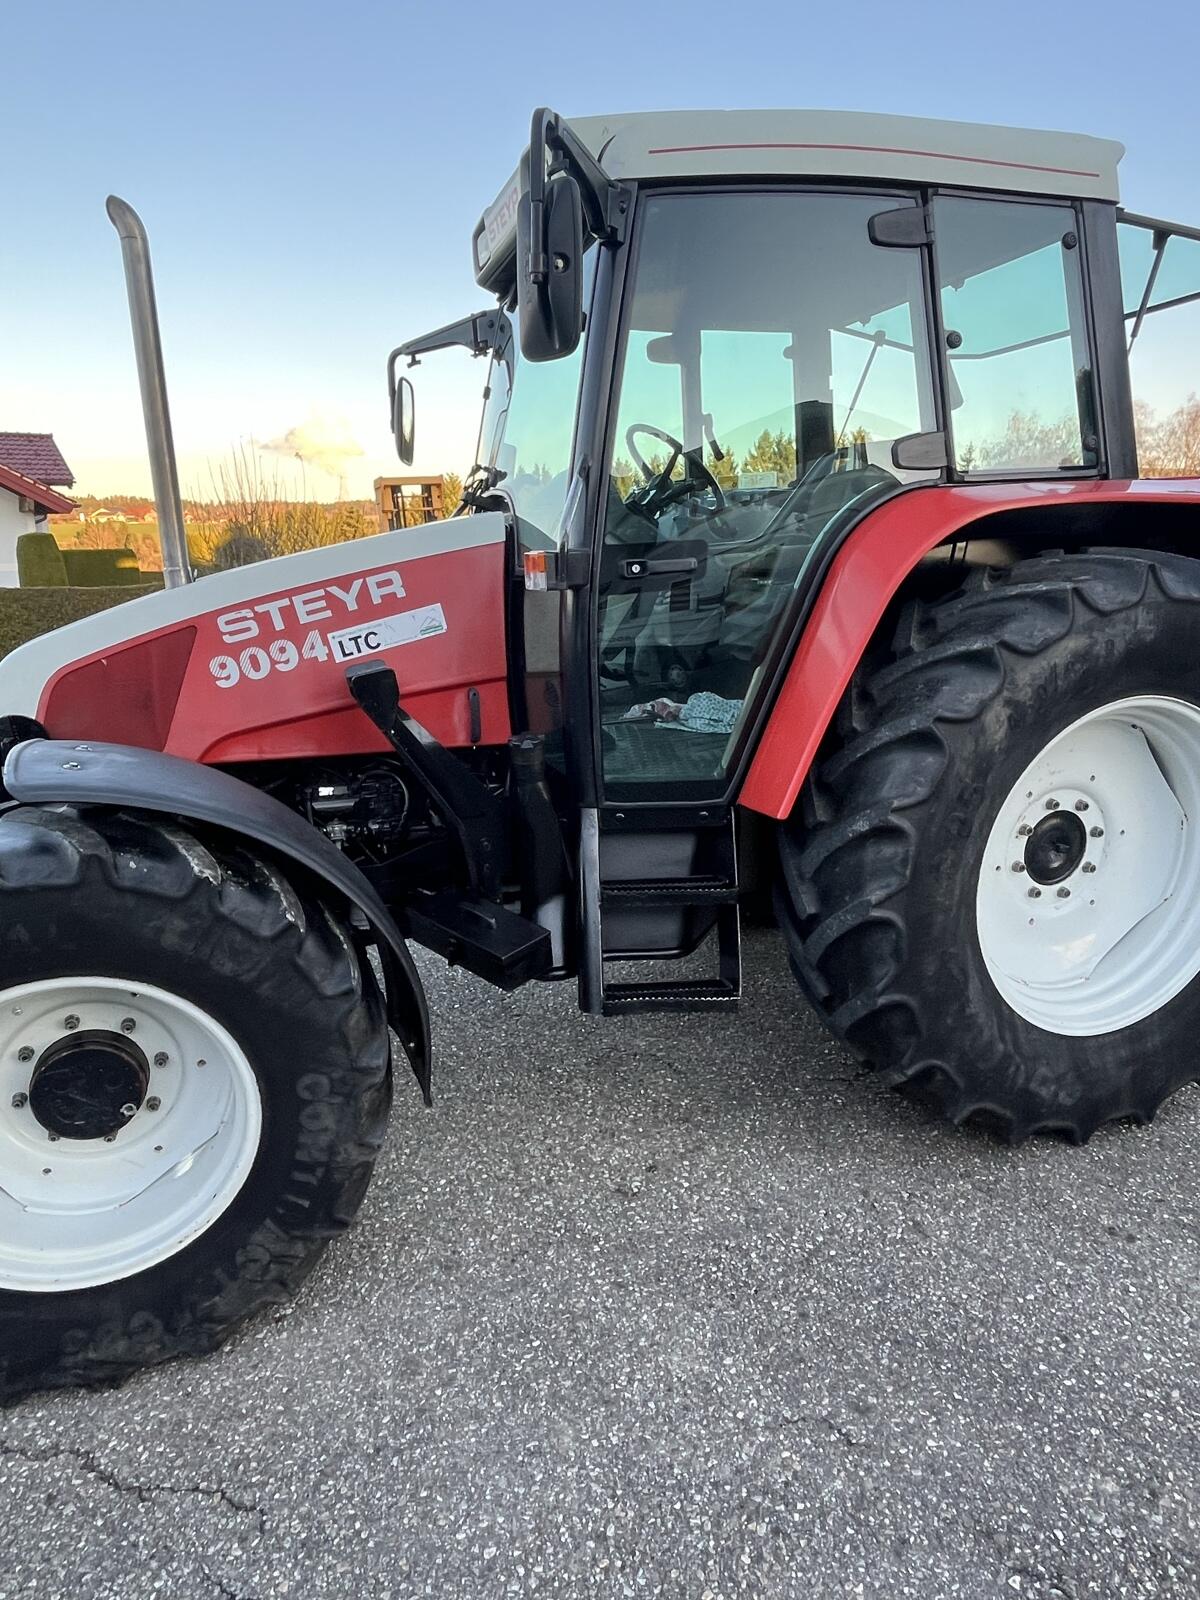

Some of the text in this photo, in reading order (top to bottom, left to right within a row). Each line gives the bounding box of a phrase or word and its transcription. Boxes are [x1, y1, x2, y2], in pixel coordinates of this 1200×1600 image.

[216, 570, 406, 644] STEYR
[209, 629, 329, 689] 9094
[338, 631, 382, 658] LTC
